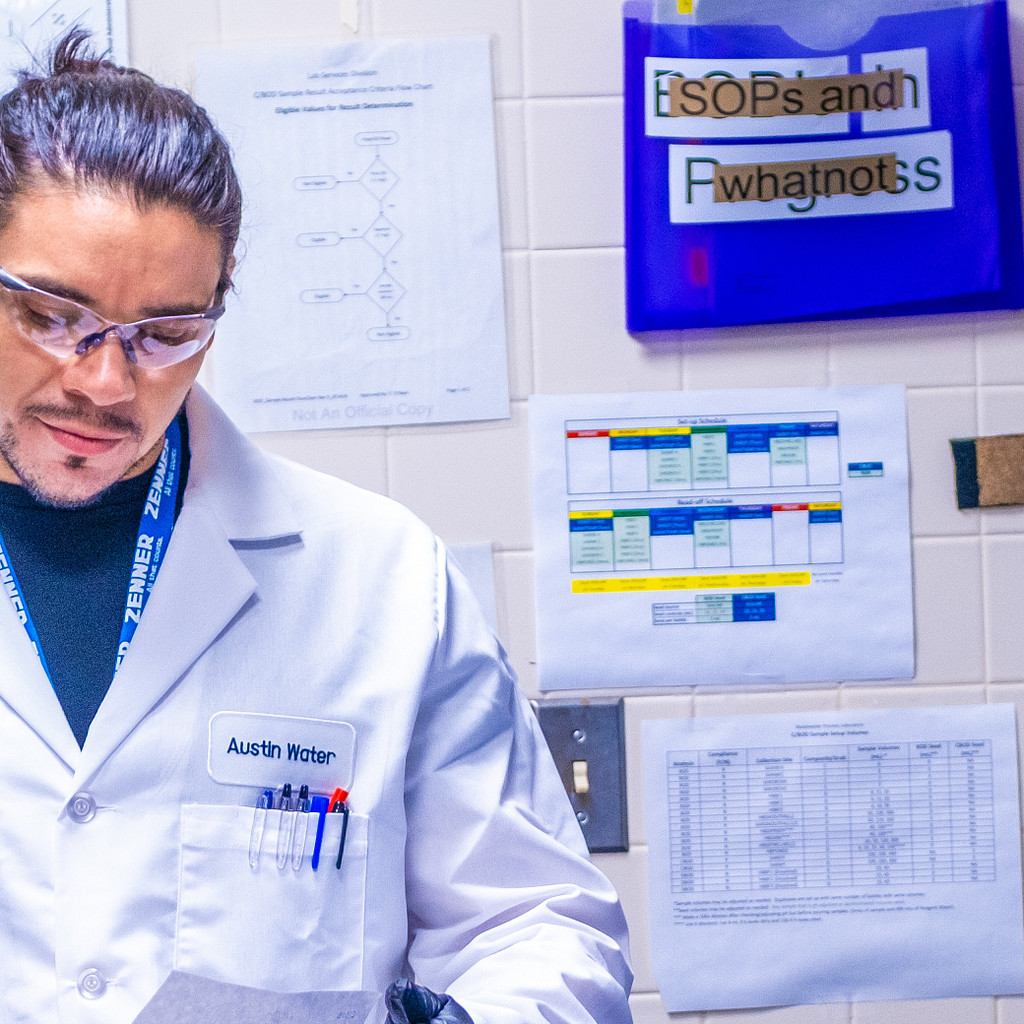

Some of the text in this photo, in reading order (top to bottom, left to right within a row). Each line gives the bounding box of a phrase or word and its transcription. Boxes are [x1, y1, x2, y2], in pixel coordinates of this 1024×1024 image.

[679, 78, 804, 116] SOPs
[819, 71, 898, 112] and
[718, 155, 888, 201] whatnot
[125, 533, 154, 624] ZENNER
[226, 736, 337, 766] Austin Water
